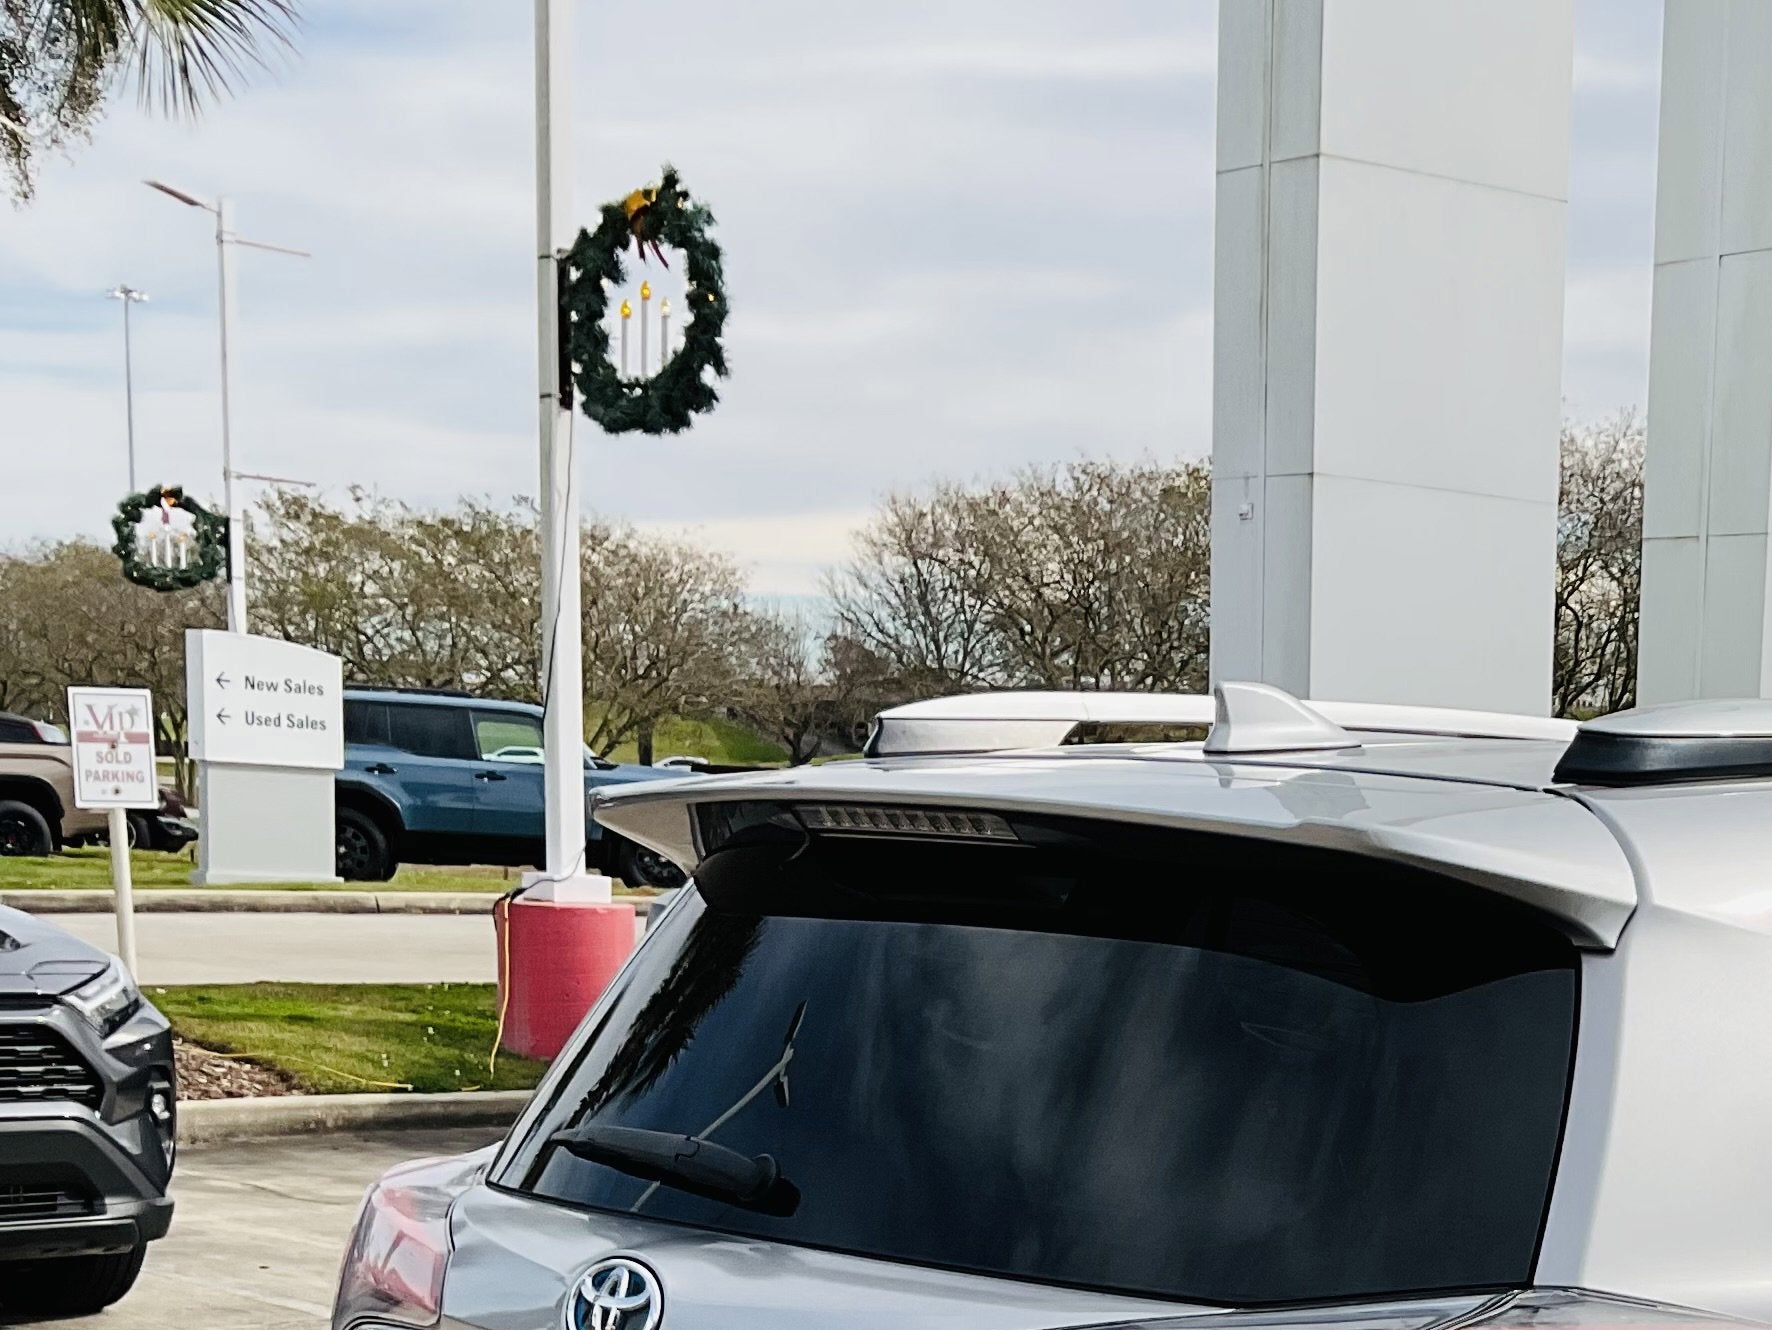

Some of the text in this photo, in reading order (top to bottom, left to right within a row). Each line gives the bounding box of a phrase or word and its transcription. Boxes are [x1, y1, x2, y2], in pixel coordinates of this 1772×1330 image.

[244, 675, 324, 696] New Sales
[245, 710, 327, 731] Used Sales
[96, 751, 132, 764] SOLD
[84, 769, 145, 783] PARKING
